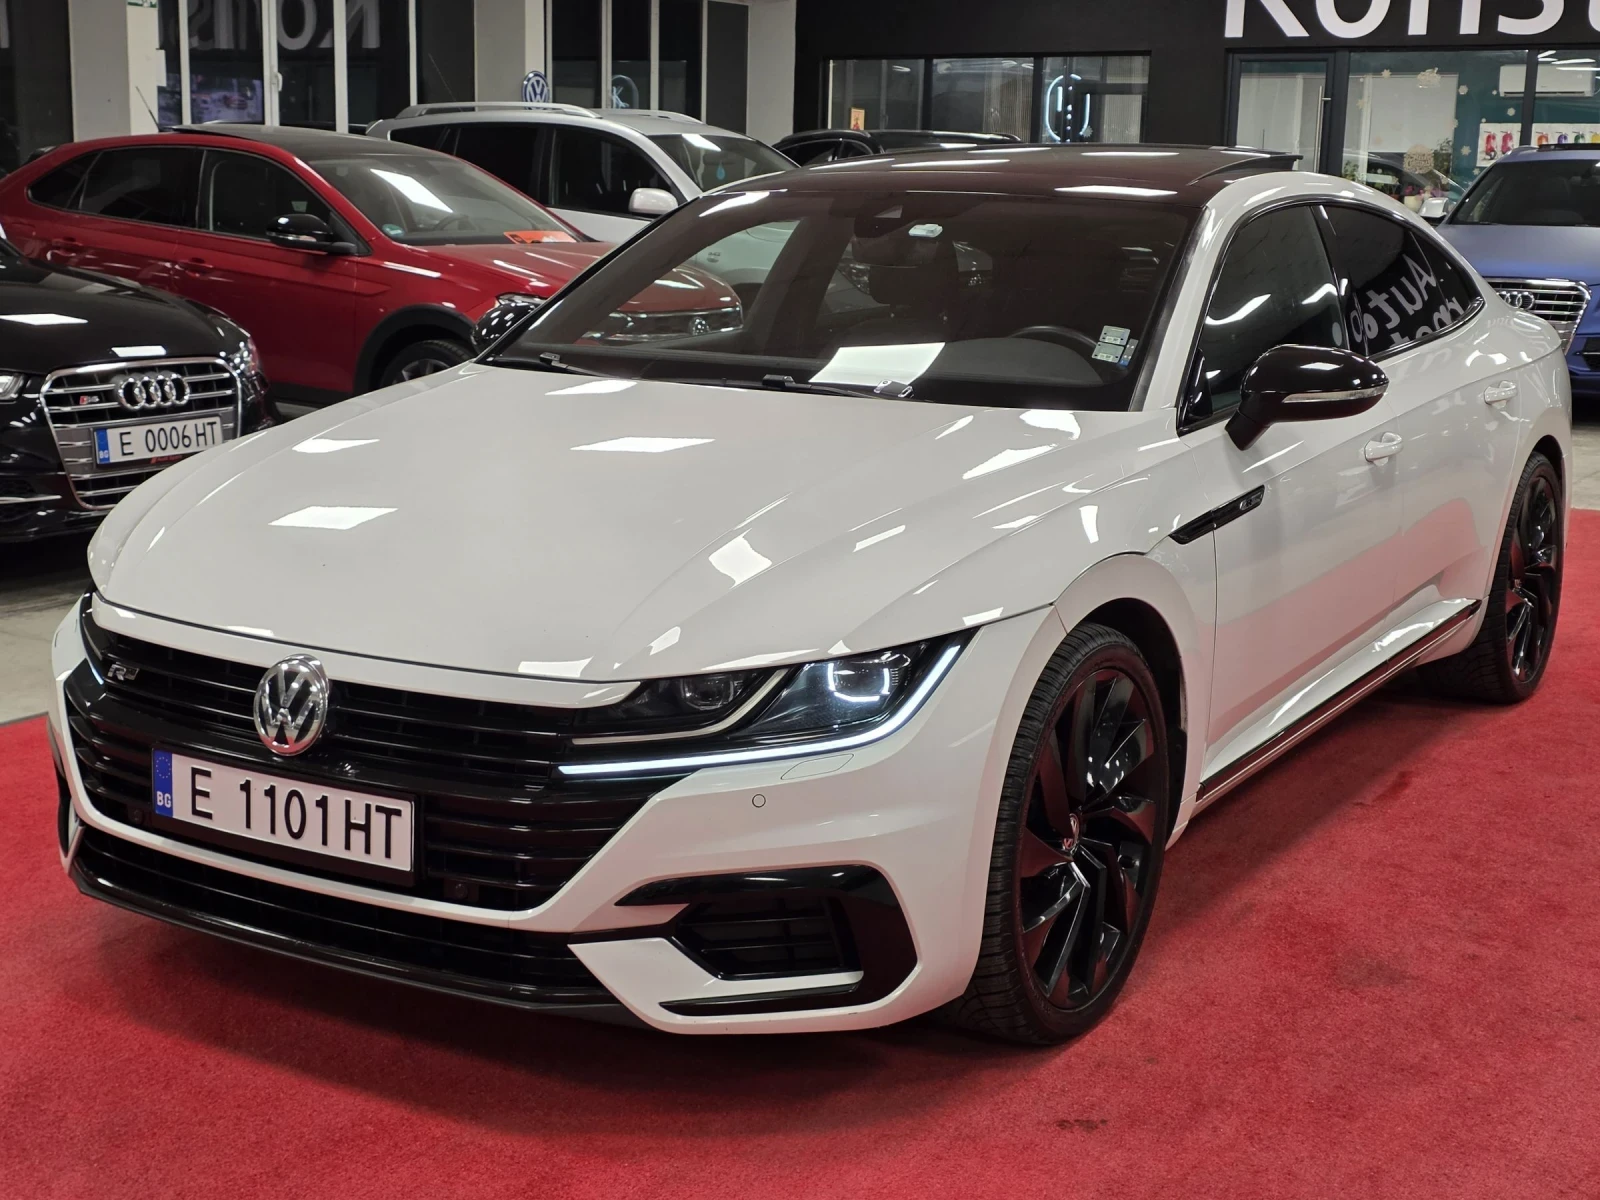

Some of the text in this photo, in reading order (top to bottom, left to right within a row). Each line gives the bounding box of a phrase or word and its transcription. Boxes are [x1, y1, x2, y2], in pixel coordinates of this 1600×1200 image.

[1224, 0, 1600, 38] ons
[119, 431, 134, 457] E
[156, 791, 172, 808] BG
[191, 766, 213, 820] E
